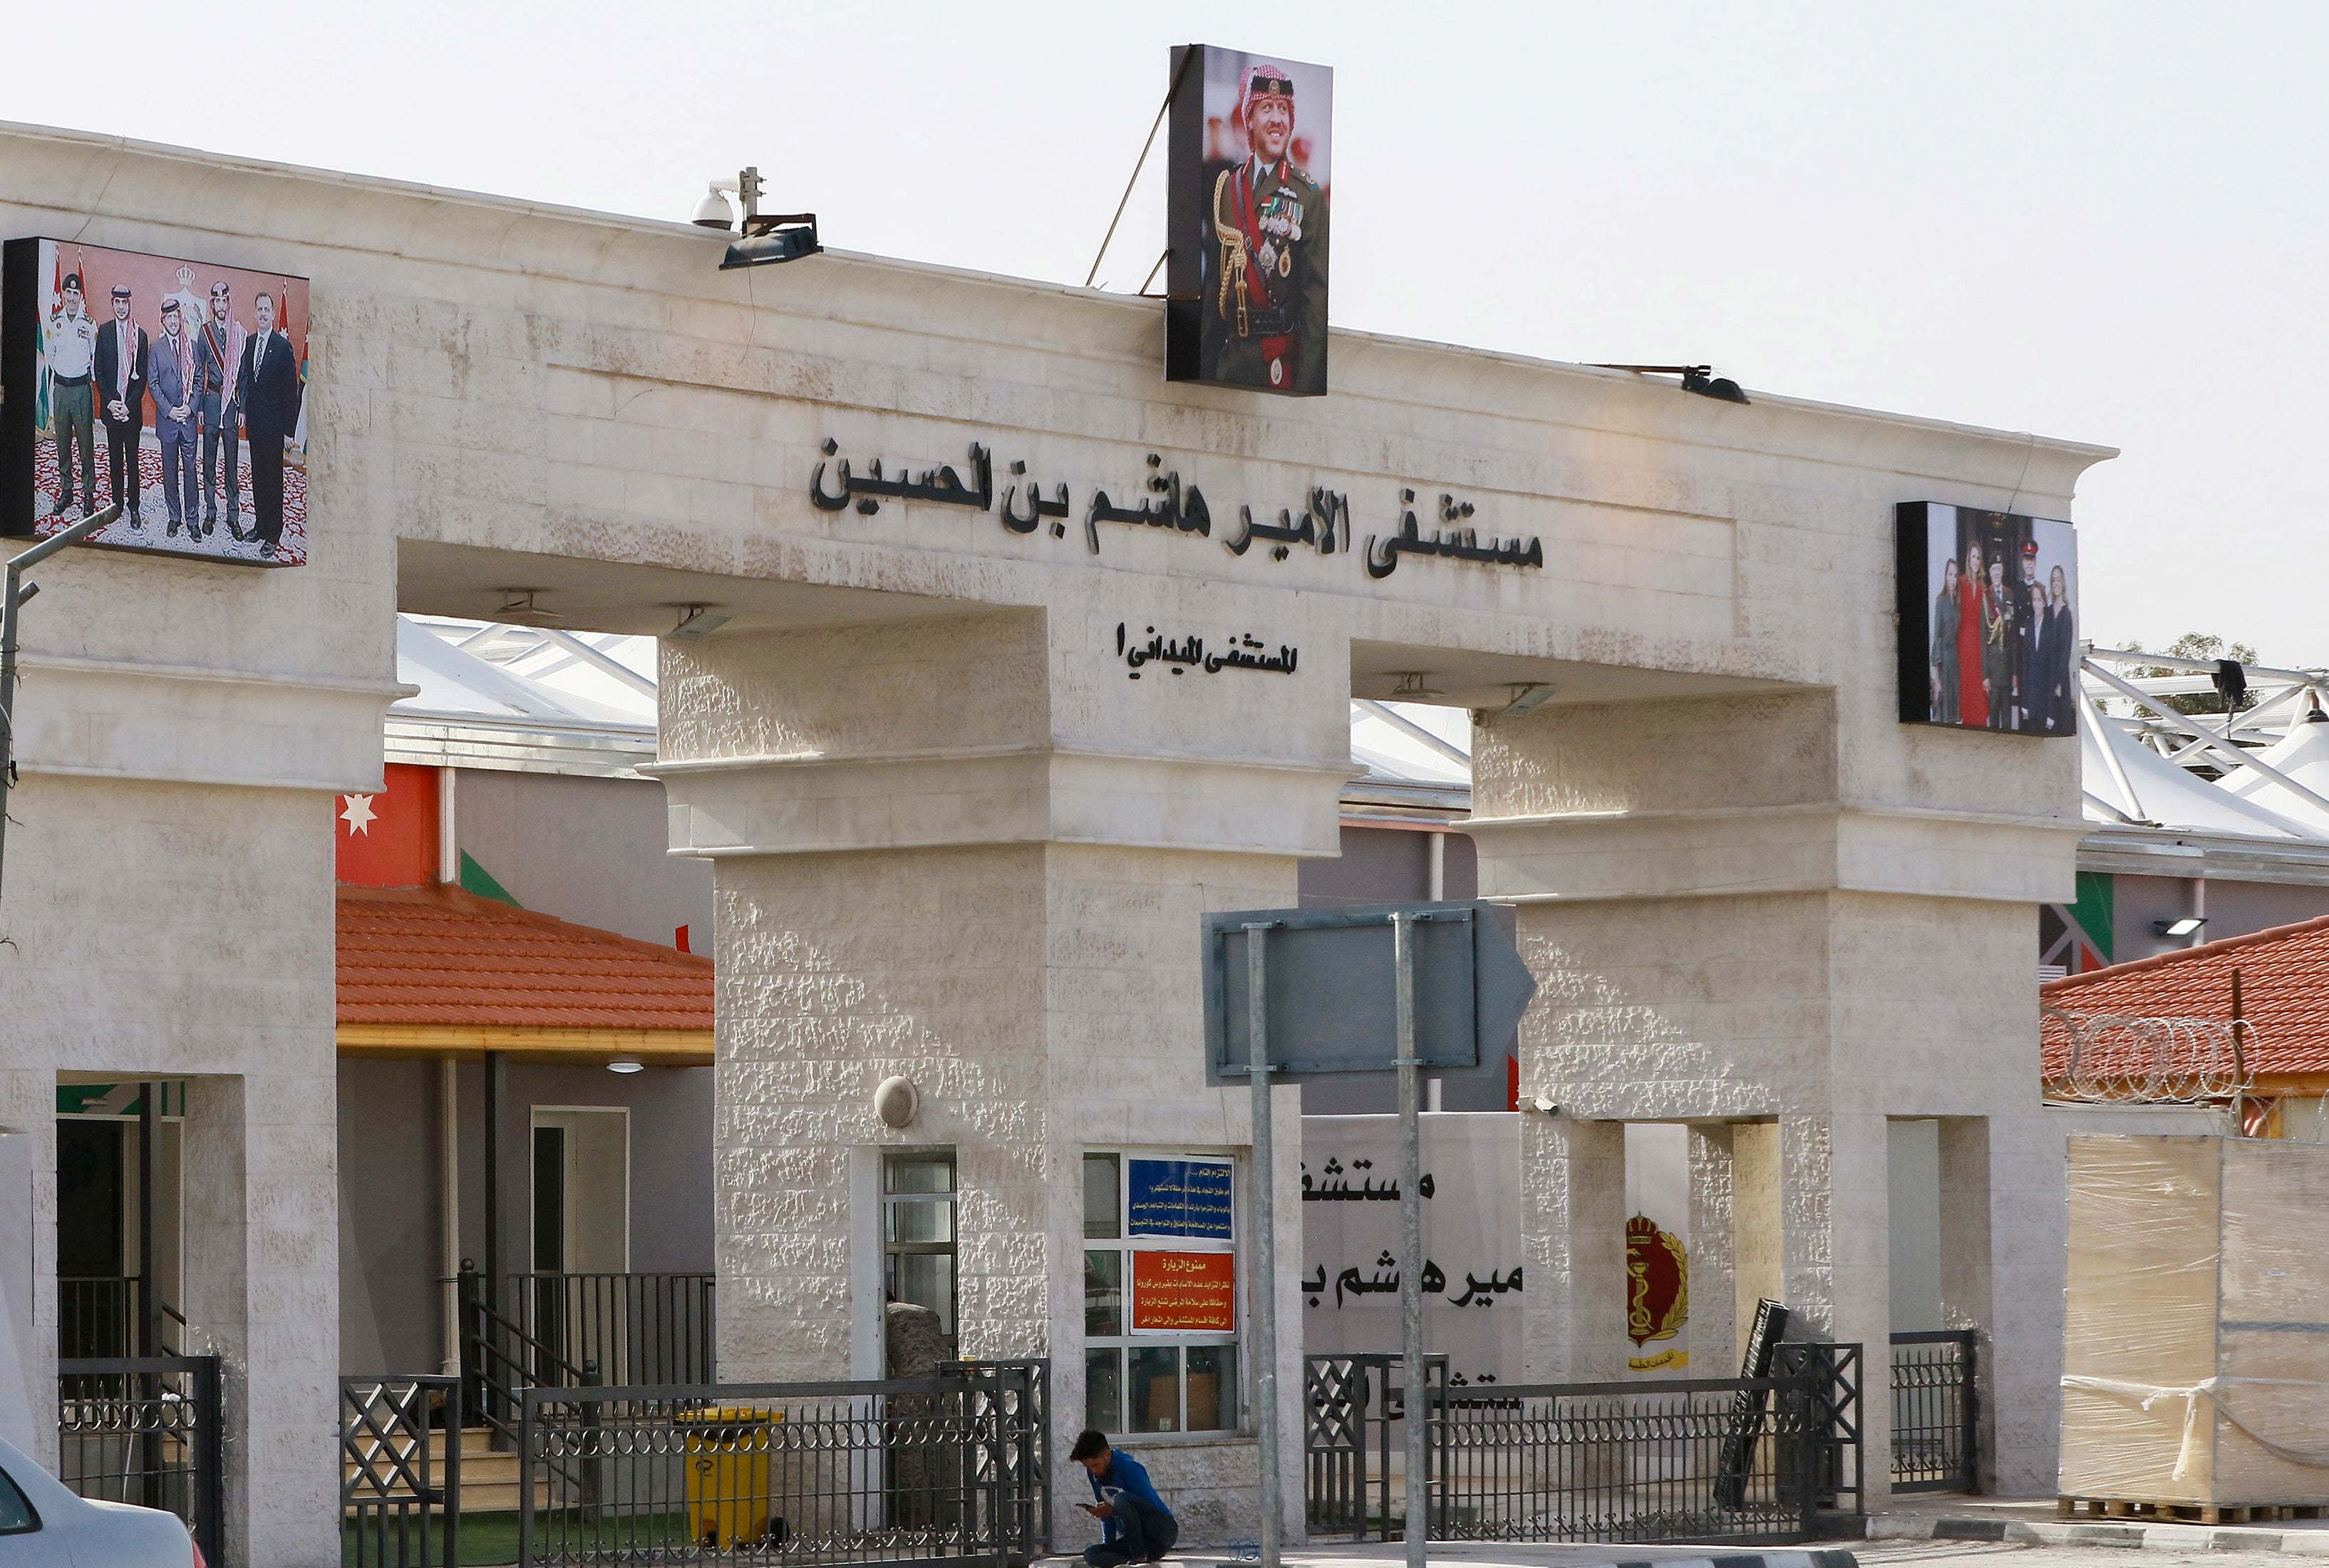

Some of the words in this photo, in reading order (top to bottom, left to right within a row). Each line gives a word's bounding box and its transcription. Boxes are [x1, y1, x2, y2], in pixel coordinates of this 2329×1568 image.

[810, 437, 992, 516] الحسين
[1001, 460, 1070, 540] بن
[1085, 453, 1212, 555] هاشم
[1365, 488, 1543, 579] مستشفى
[1127, 626, 1203, 680] الميداني
[1204, 633, 1298, 675] المستشفى
[1137, 1279, 1152, 1288] كورونا
[1162, 1259, 1186, 1272] الزيارة
[1187, 1259, 1206, 1272] ممنوع
[1336, 1249, 1447, 1311] هشم
